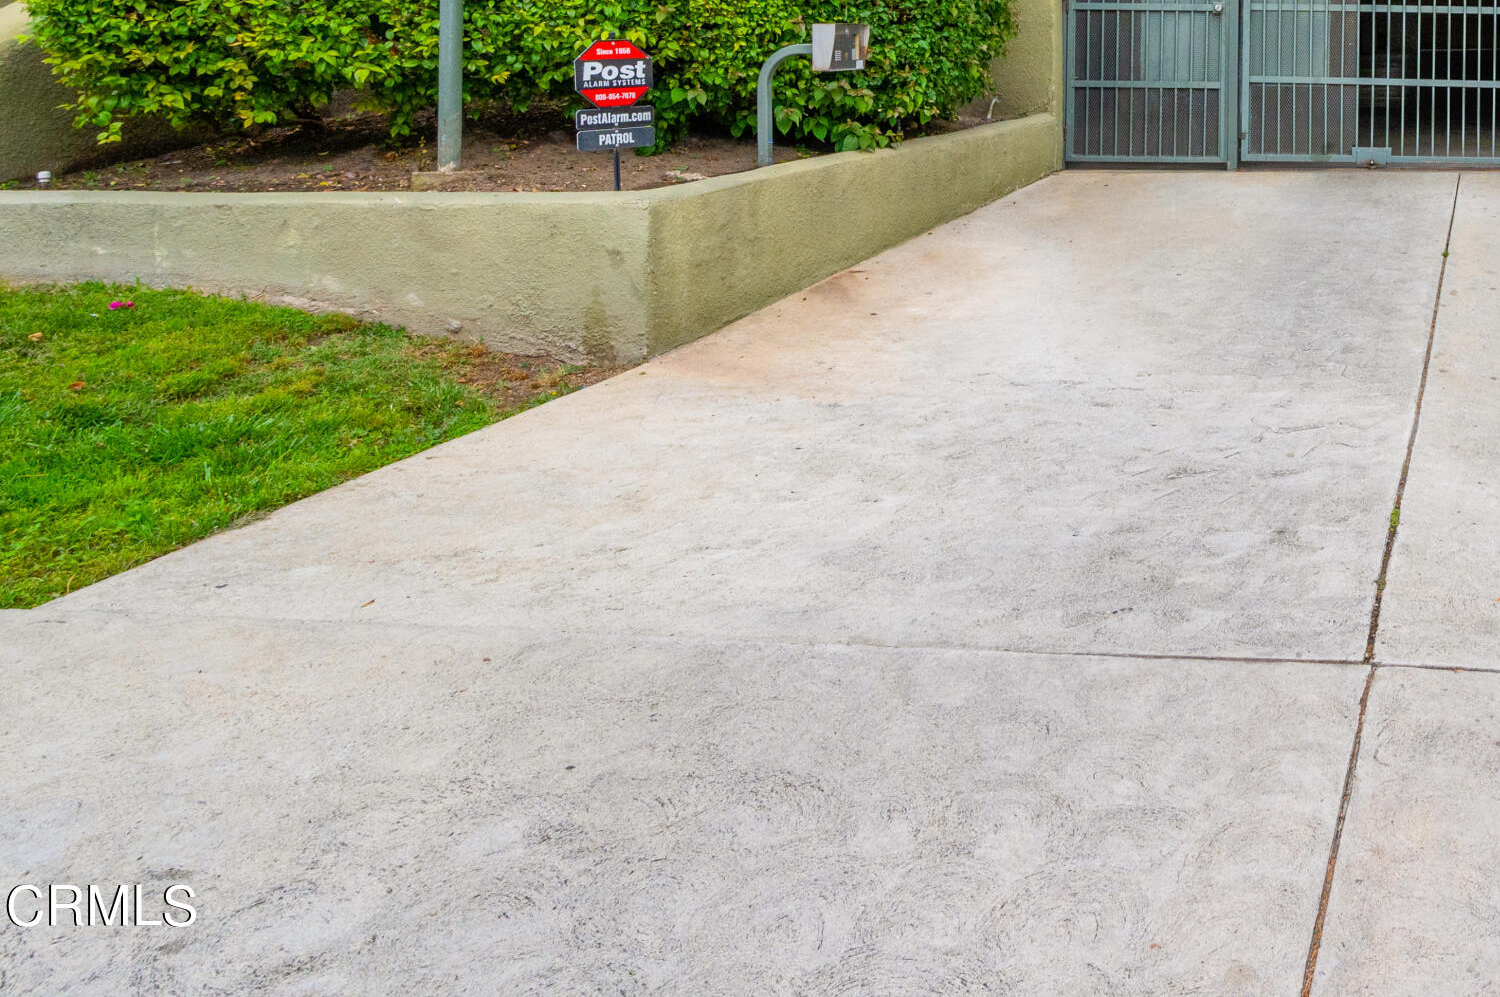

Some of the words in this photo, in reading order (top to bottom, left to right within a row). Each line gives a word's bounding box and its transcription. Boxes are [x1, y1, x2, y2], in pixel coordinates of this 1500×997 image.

[582, 60, 646, 81] Post
[612, 78, 646, 87] SYSTEMS
[580, 111, 652, 126] PostAlarm.com
[598, 132, 635, 146] PATROL
